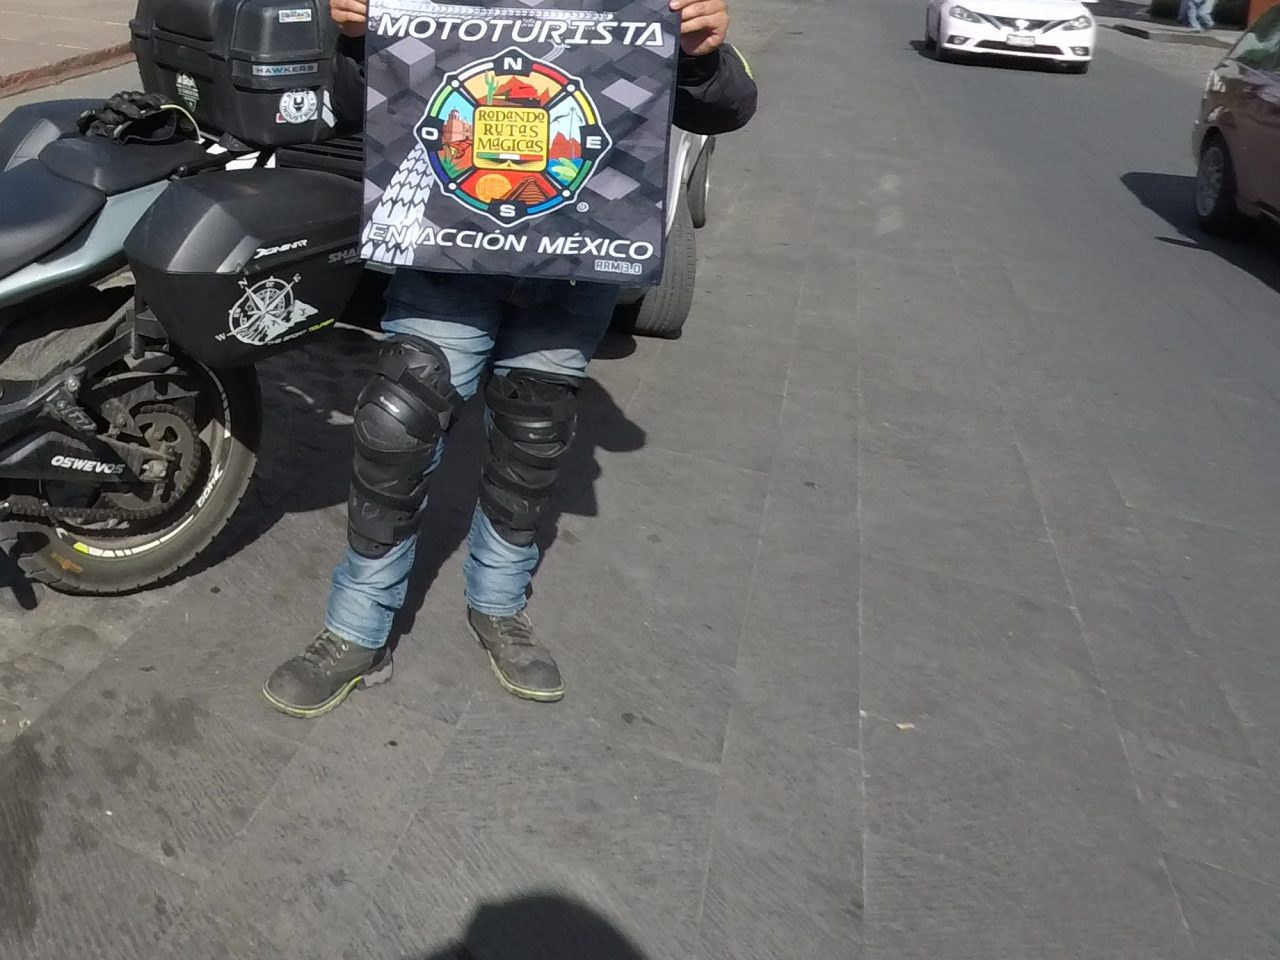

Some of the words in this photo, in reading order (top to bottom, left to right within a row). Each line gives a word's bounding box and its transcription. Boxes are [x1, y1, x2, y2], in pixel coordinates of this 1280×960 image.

[376, 13, 664, 47] MOTOTURISTA
[256, 64, 314, 74] HAWKERS
[503, 57, 523, 71] N
[421, 127, 439, 140] O
[586, 135, 602, 149] E
[499, 204, 516, 218] S
[367, 223, 408, 245] EN
[416, 229, 527, 253] ACCIÓN
[536, 233, 655, 260] MÉXICO
[328, 247, 362, 263] SHA
[51, 455, 126, 475] OSWEVOS
